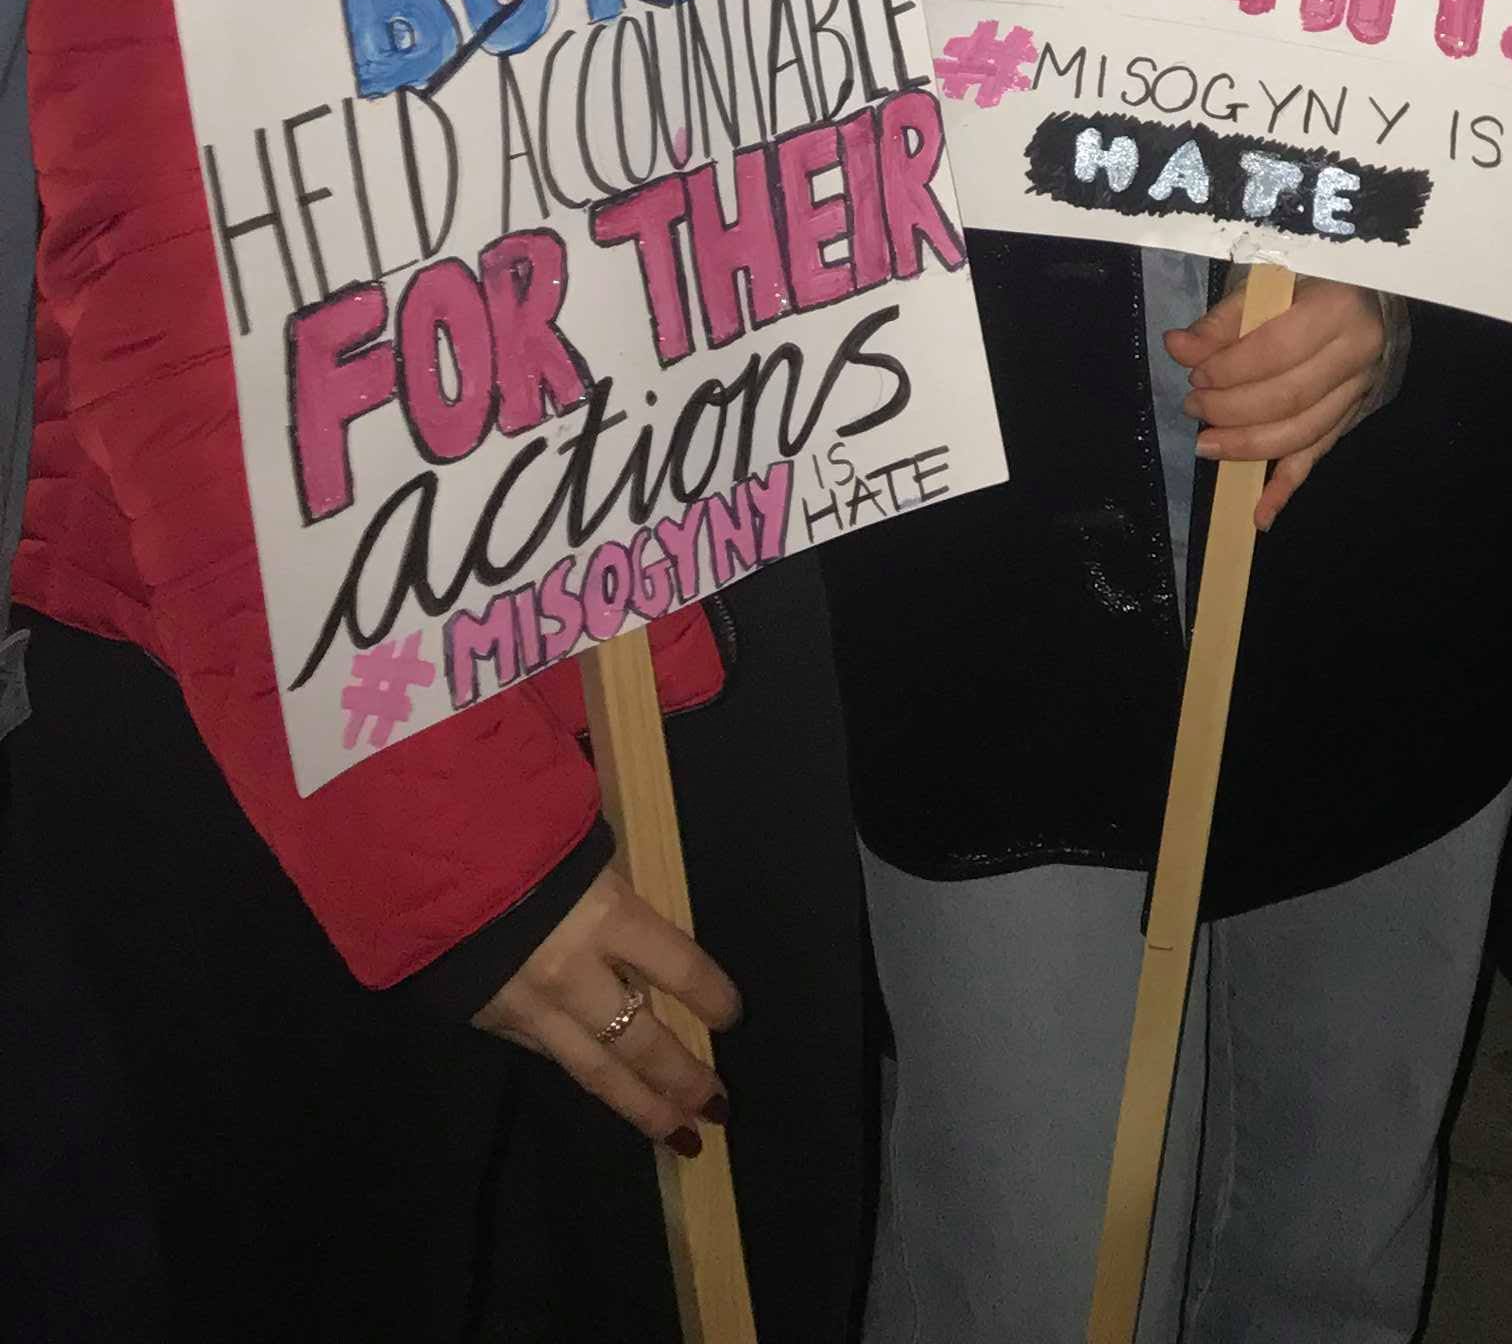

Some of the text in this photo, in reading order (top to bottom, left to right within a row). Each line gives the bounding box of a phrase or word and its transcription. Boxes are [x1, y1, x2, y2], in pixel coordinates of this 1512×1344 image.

[204, 84, 459, 334] HELD
[933, 19, 1503, 168] #MISOGYNY IS
[1073, 128, 1360, 235] HATE
[287, 89, 968, 526] FOR THEIR
[288, 305, 912, 690] actions
[340, 442, 855, 750] #MISOGYNY IS
[801, 445, 952, 544] HATE
